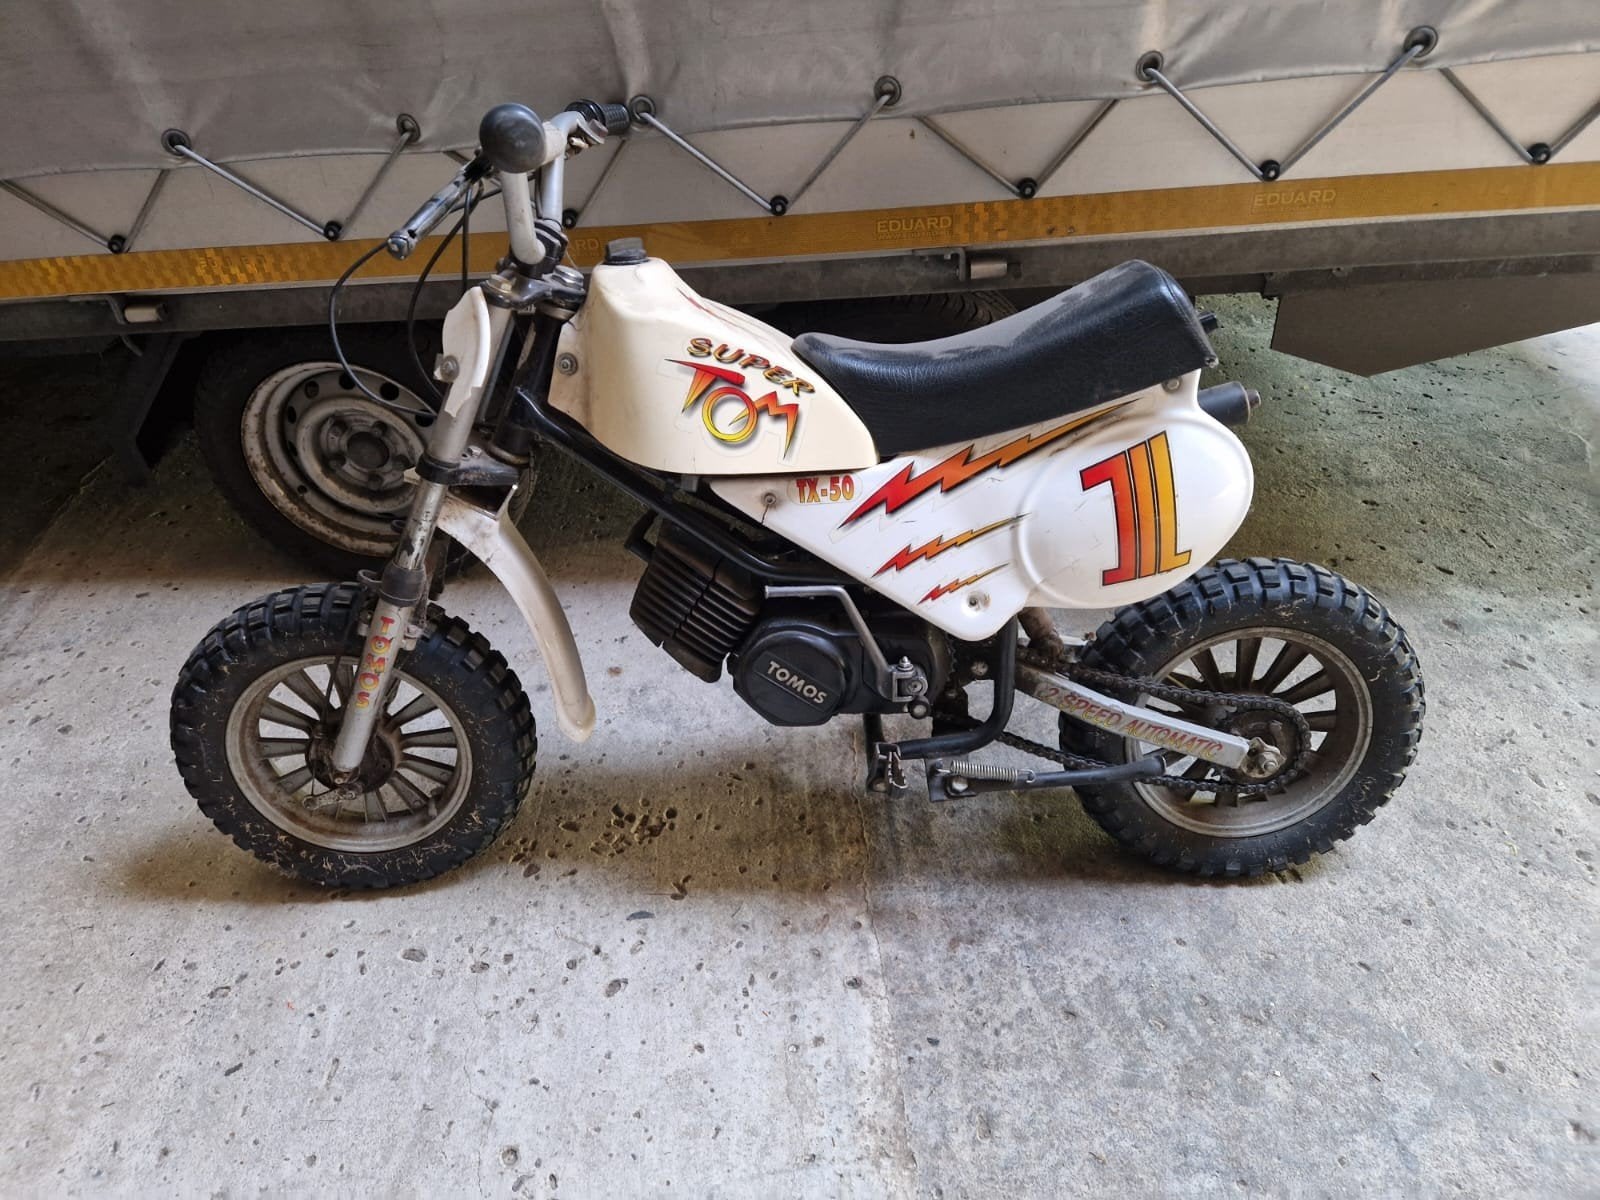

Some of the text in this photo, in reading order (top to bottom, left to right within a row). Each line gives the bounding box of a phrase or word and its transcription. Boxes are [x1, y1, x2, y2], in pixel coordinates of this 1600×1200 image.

[1254, 189, 1337, 206] EDUARD
[877, 215, 952, 233] EDUARD
[686, 337, 815, 396] SUPER
[664, 358, 799, 460] TOM
[796, 475, 855, 504] TX-50
[356, 615, 395, 709] TOMOS
[766, 660, 828, 704] TOMOS
[1040, 687, 1223, 759] 2 SPEED AUTOMATIC
